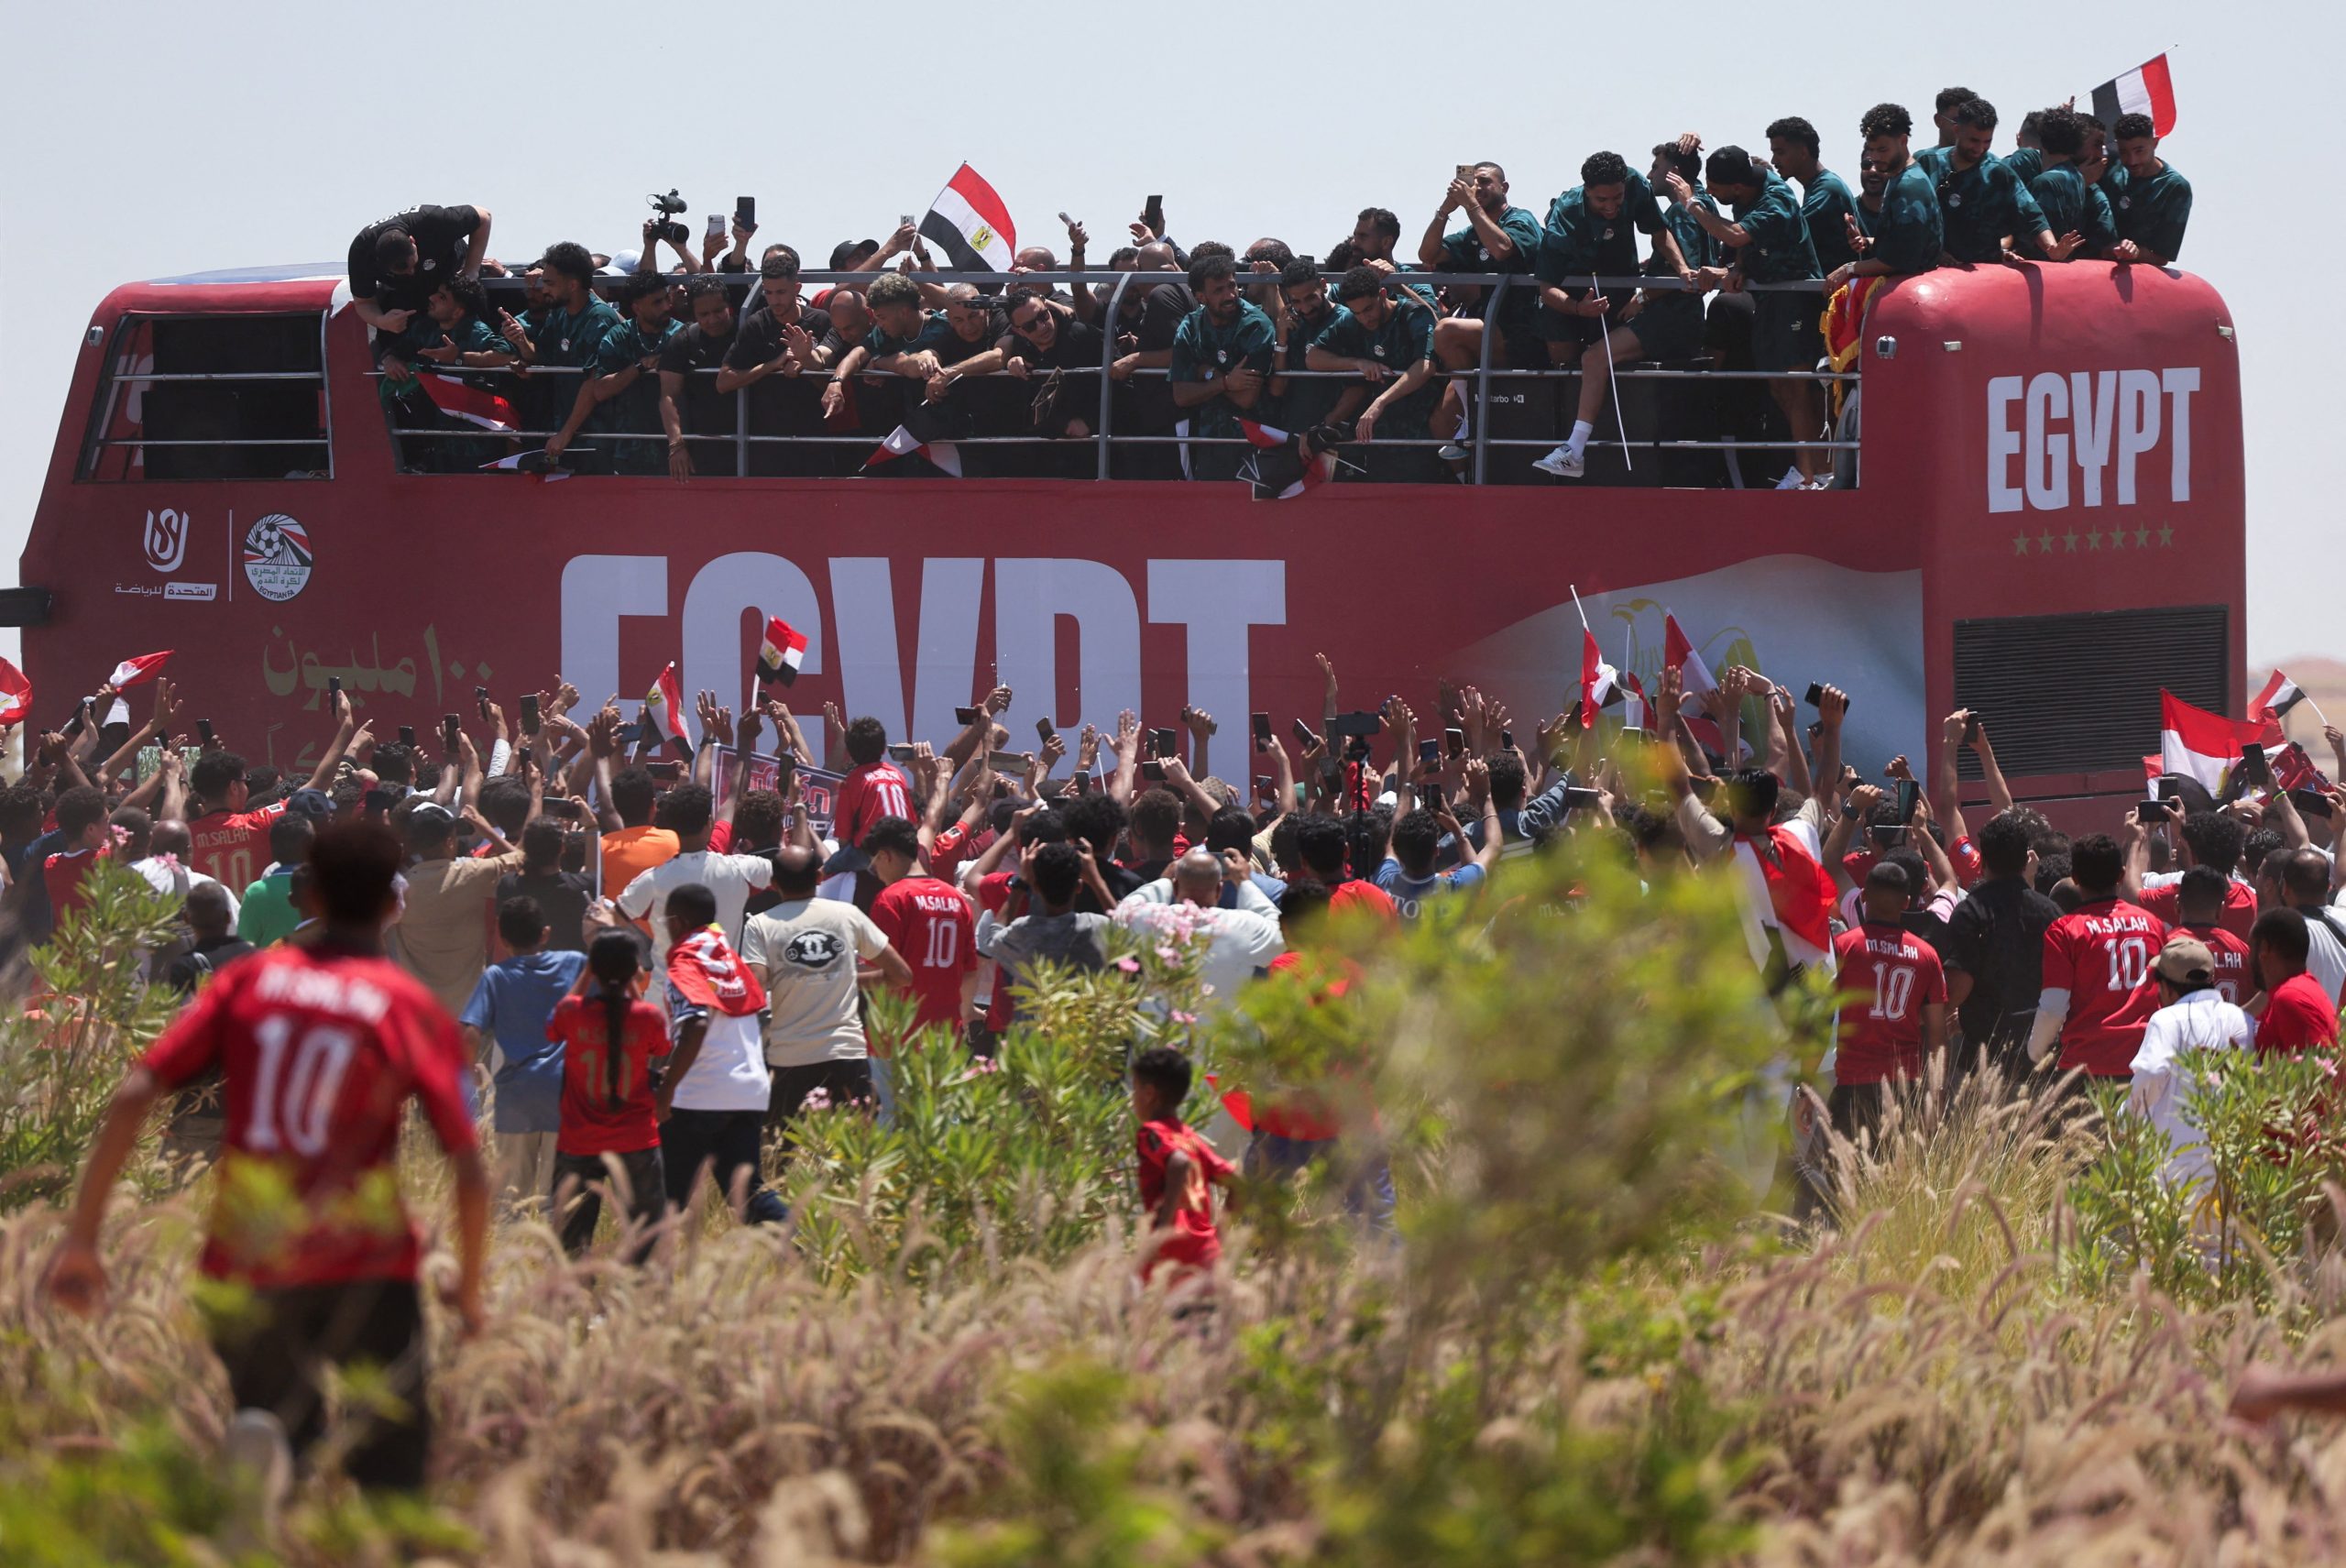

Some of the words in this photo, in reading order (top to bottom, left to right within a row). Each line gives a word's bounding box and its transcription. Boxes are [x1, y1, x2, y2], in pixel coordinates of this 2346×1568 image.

[1987, 367, 2201, 514] EGYPT
[115, 582, 162, 598] للرياضة
[167, 584, 214, 597] المتحدة
[258, 586, 288, 599] EGYPTIAN
[287, 589, 295, 598] FA
[560, 552, 1287, 803] EGYPT
[196, 826, 250, 849] M.SALAH
[205, 848, 253, 903] 10
[923, 916, 958, 969] 10
[1865, 938, 1919, 960] M.SALAH
[2086, 916, 2150, 935] M.SALAH
[1869, 960, 1917, 1022] 10
[2103, 937, 2148, 992] 10
[245, 1013, 357, 1157] 10
